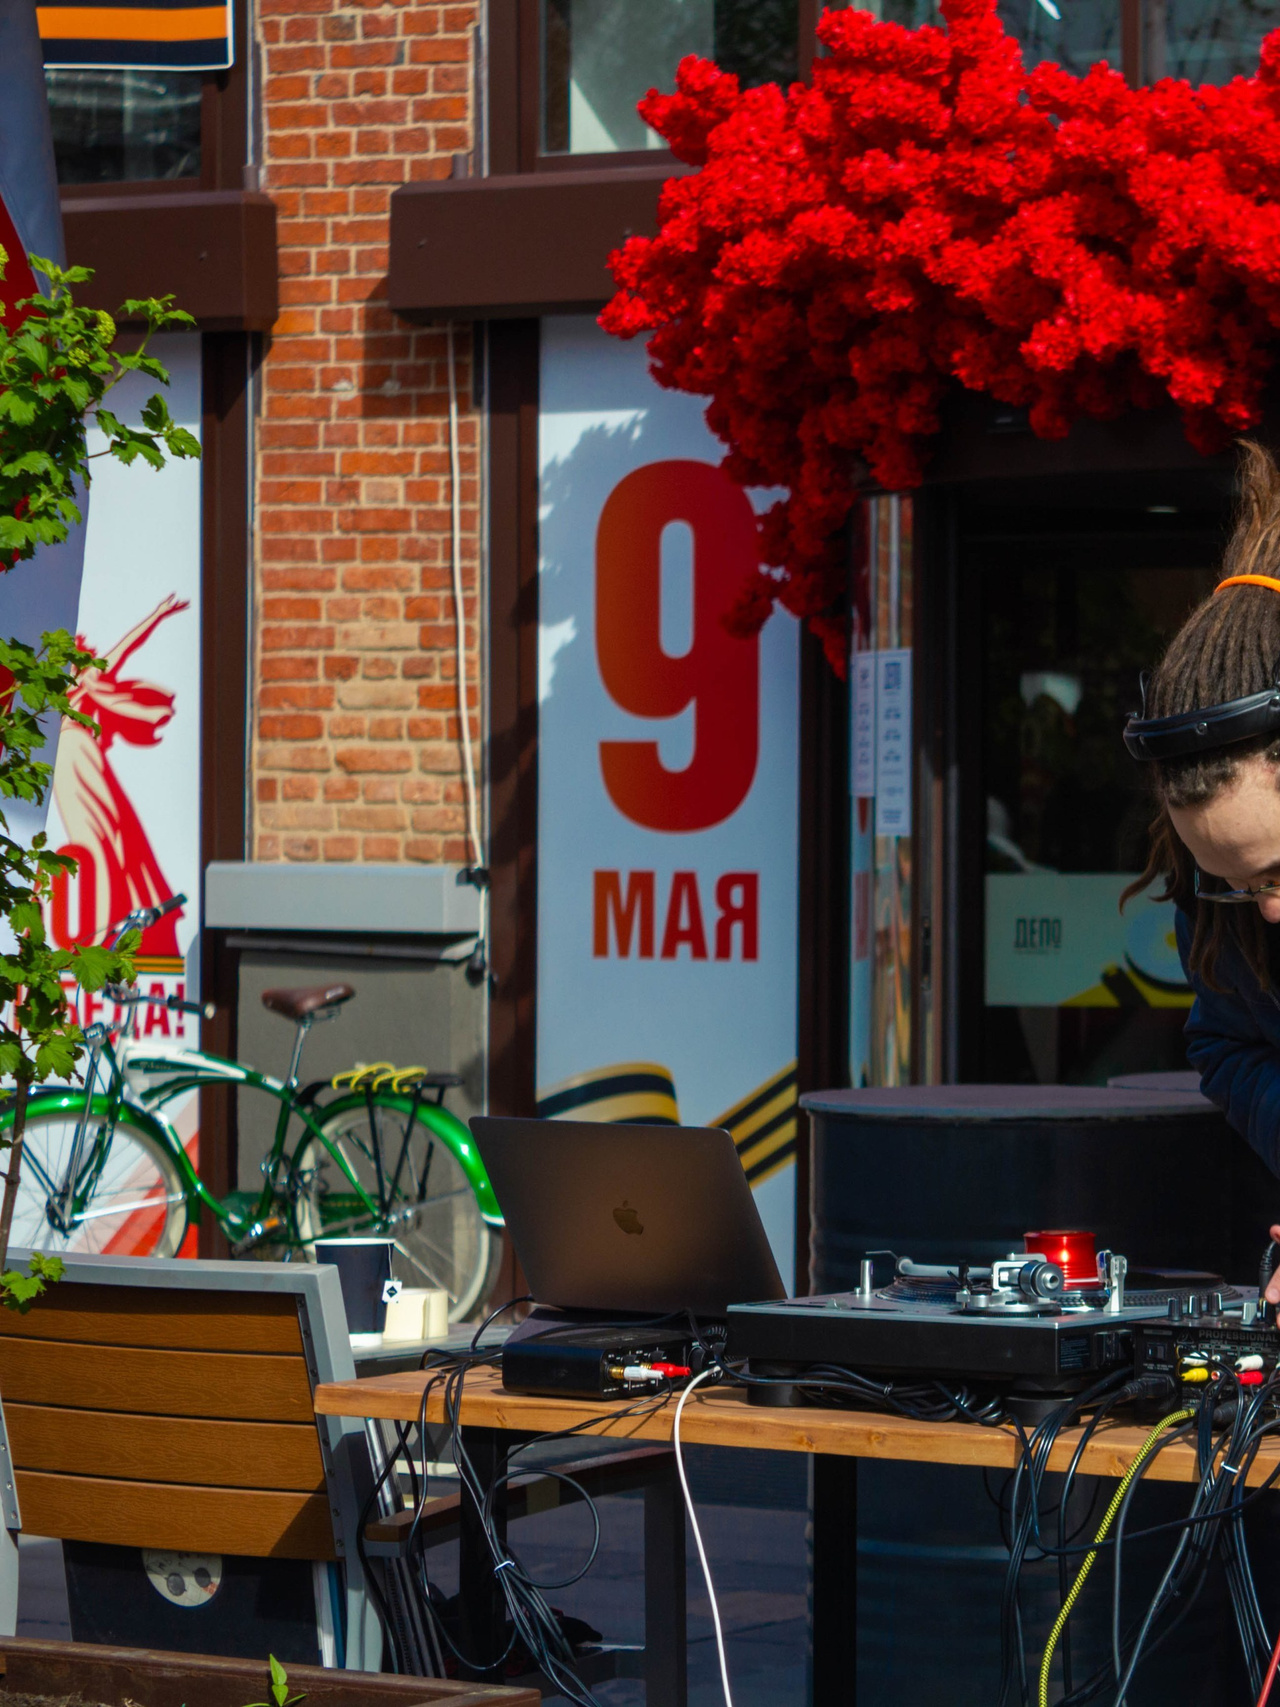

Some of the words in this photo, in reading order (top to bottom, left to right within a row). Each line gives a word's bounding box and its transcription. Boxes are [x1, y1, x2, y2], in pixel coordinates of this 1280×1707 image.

[595, 459, 760, 834] 9
[593, 870, 759, 962] МАЯ
[1014, 917, 1062, 949] ДЕПО
[1198, 1329, 1278, 1342] PROFESSIONAL
